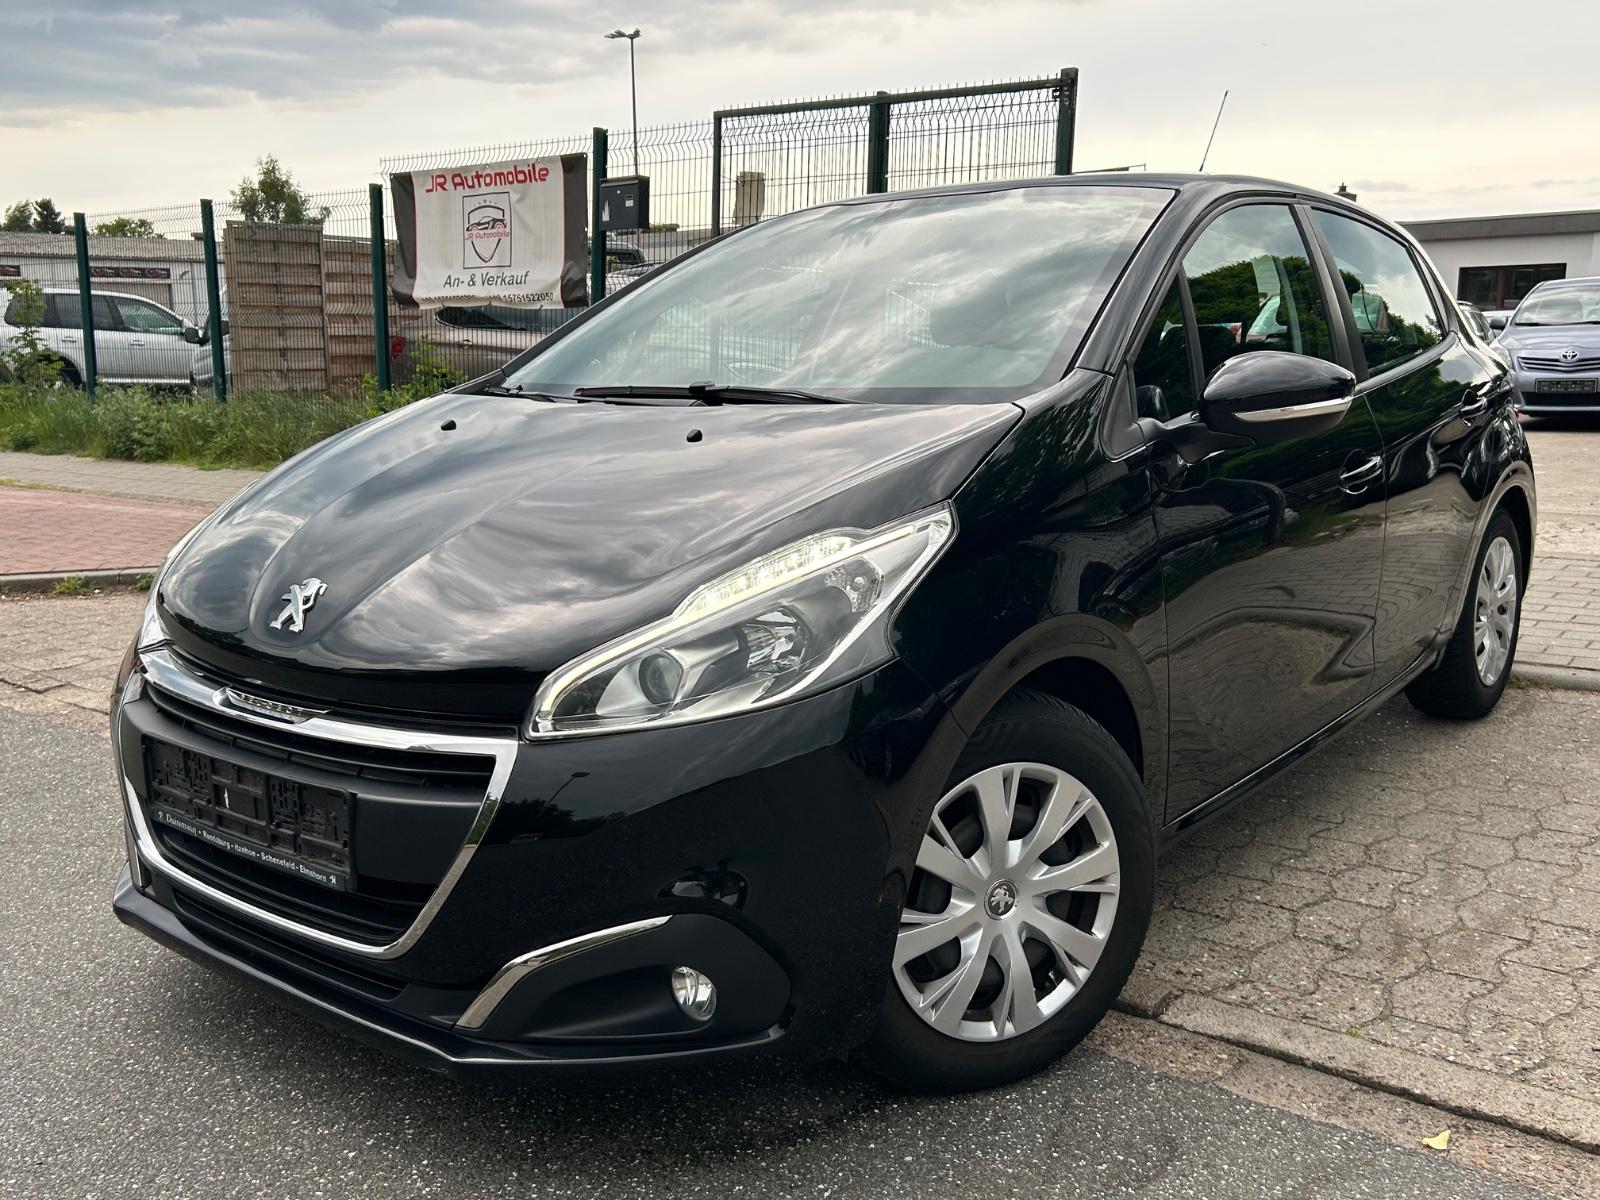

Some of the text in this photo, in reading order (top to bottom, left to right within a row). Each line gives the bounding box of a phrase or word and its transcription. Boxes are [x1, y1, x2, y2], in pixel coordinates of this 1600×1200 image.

[425, 163, 550, 193] JR Automobile
[475, 230, 511, 240] Automobile
[443, 270, 530, 288] An- & Verkauf
[260, 851, 296, 870] Schenefeld
[299, 864, 327, 883] Elmshorn
